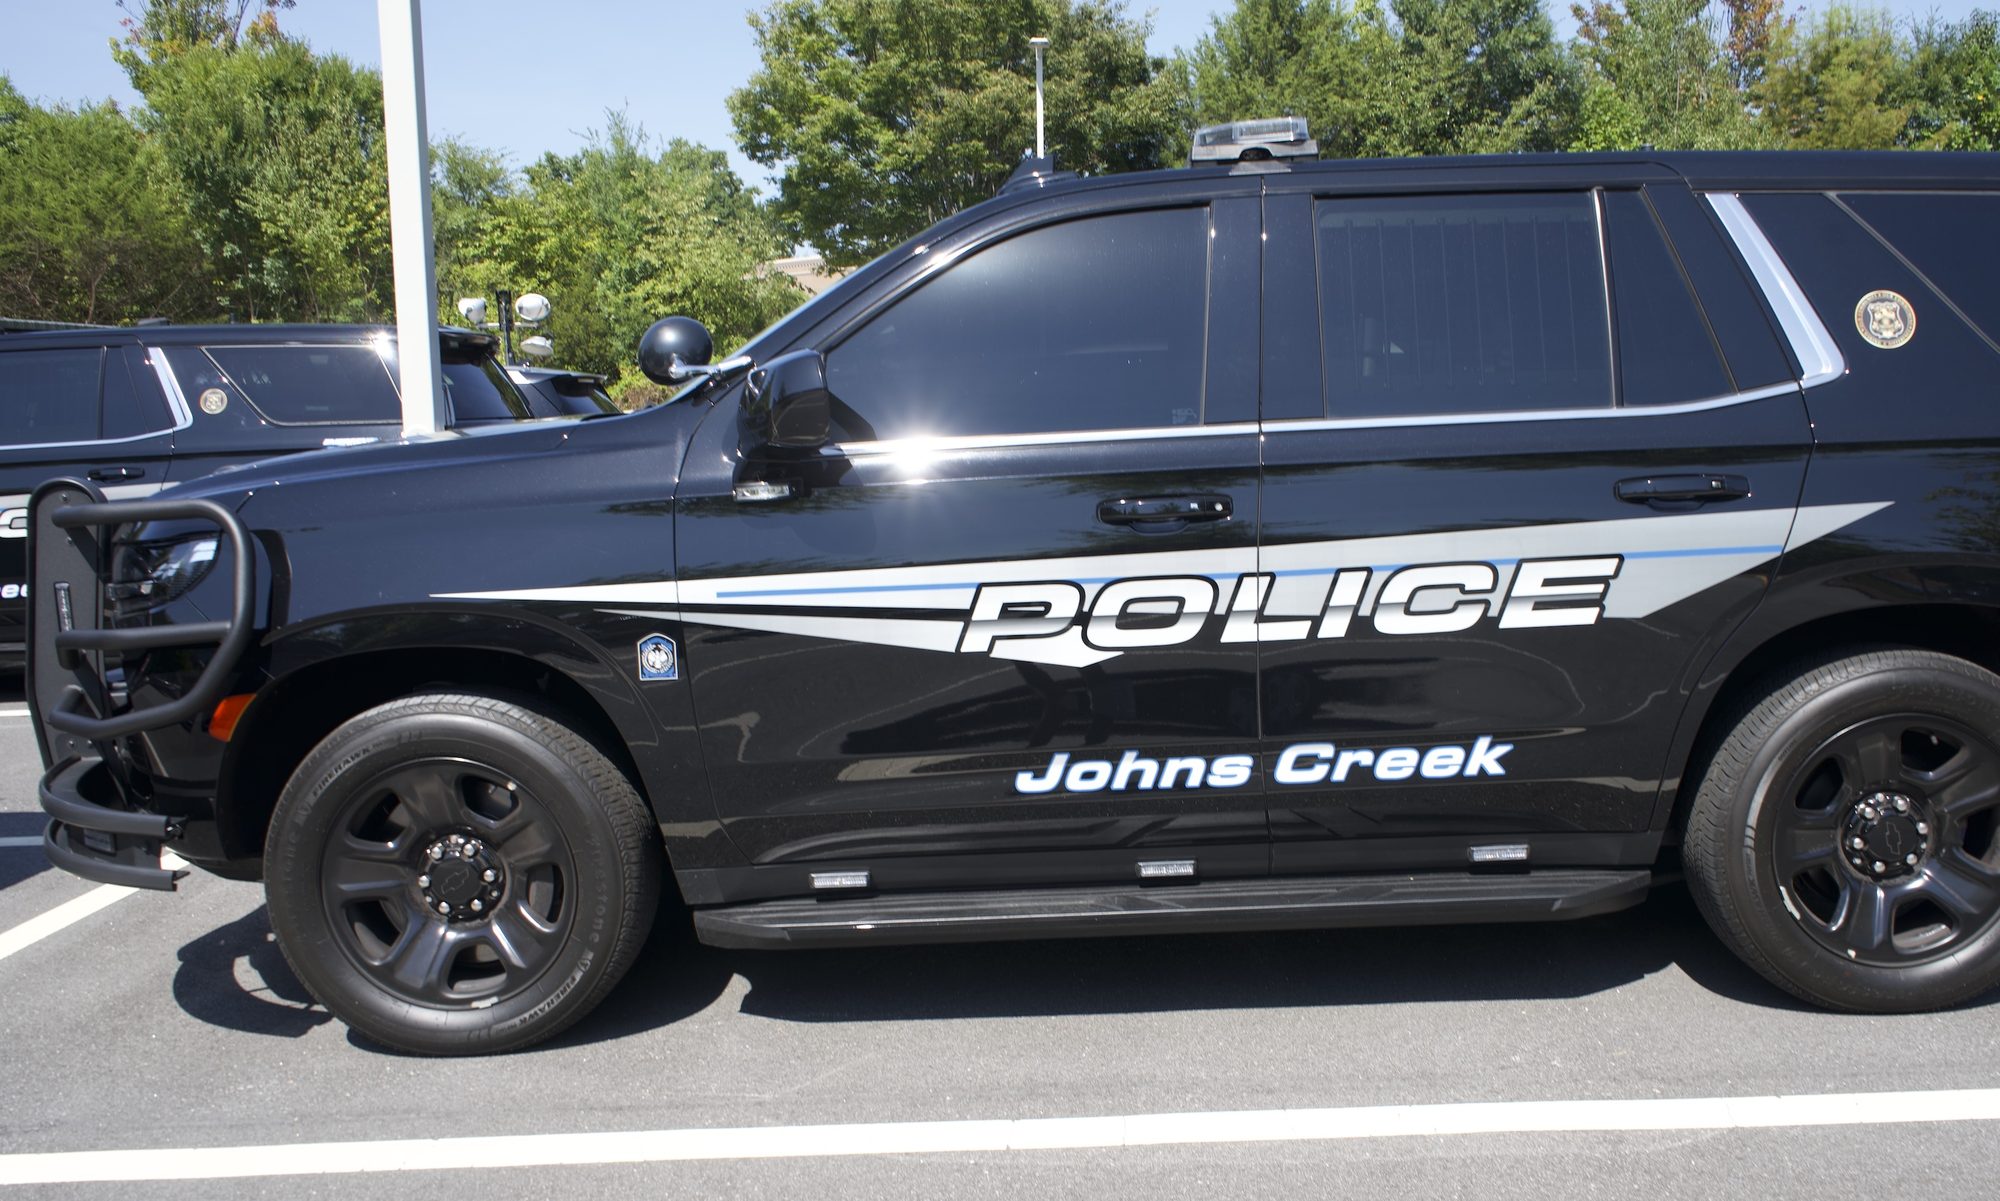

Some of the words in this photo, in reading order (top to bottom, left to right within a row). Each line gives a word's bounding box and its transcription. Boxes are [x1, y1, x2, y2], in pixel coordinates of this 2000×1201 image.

[957, 554, 1624, 652] POLICE
[312, 748, 370, 798] FIREHAWK
[1014, 750, 1254, 794] Johns
[1274, 735, 1515, 784] Creek
[518, 975, 577, 1025] FIREHAWK
